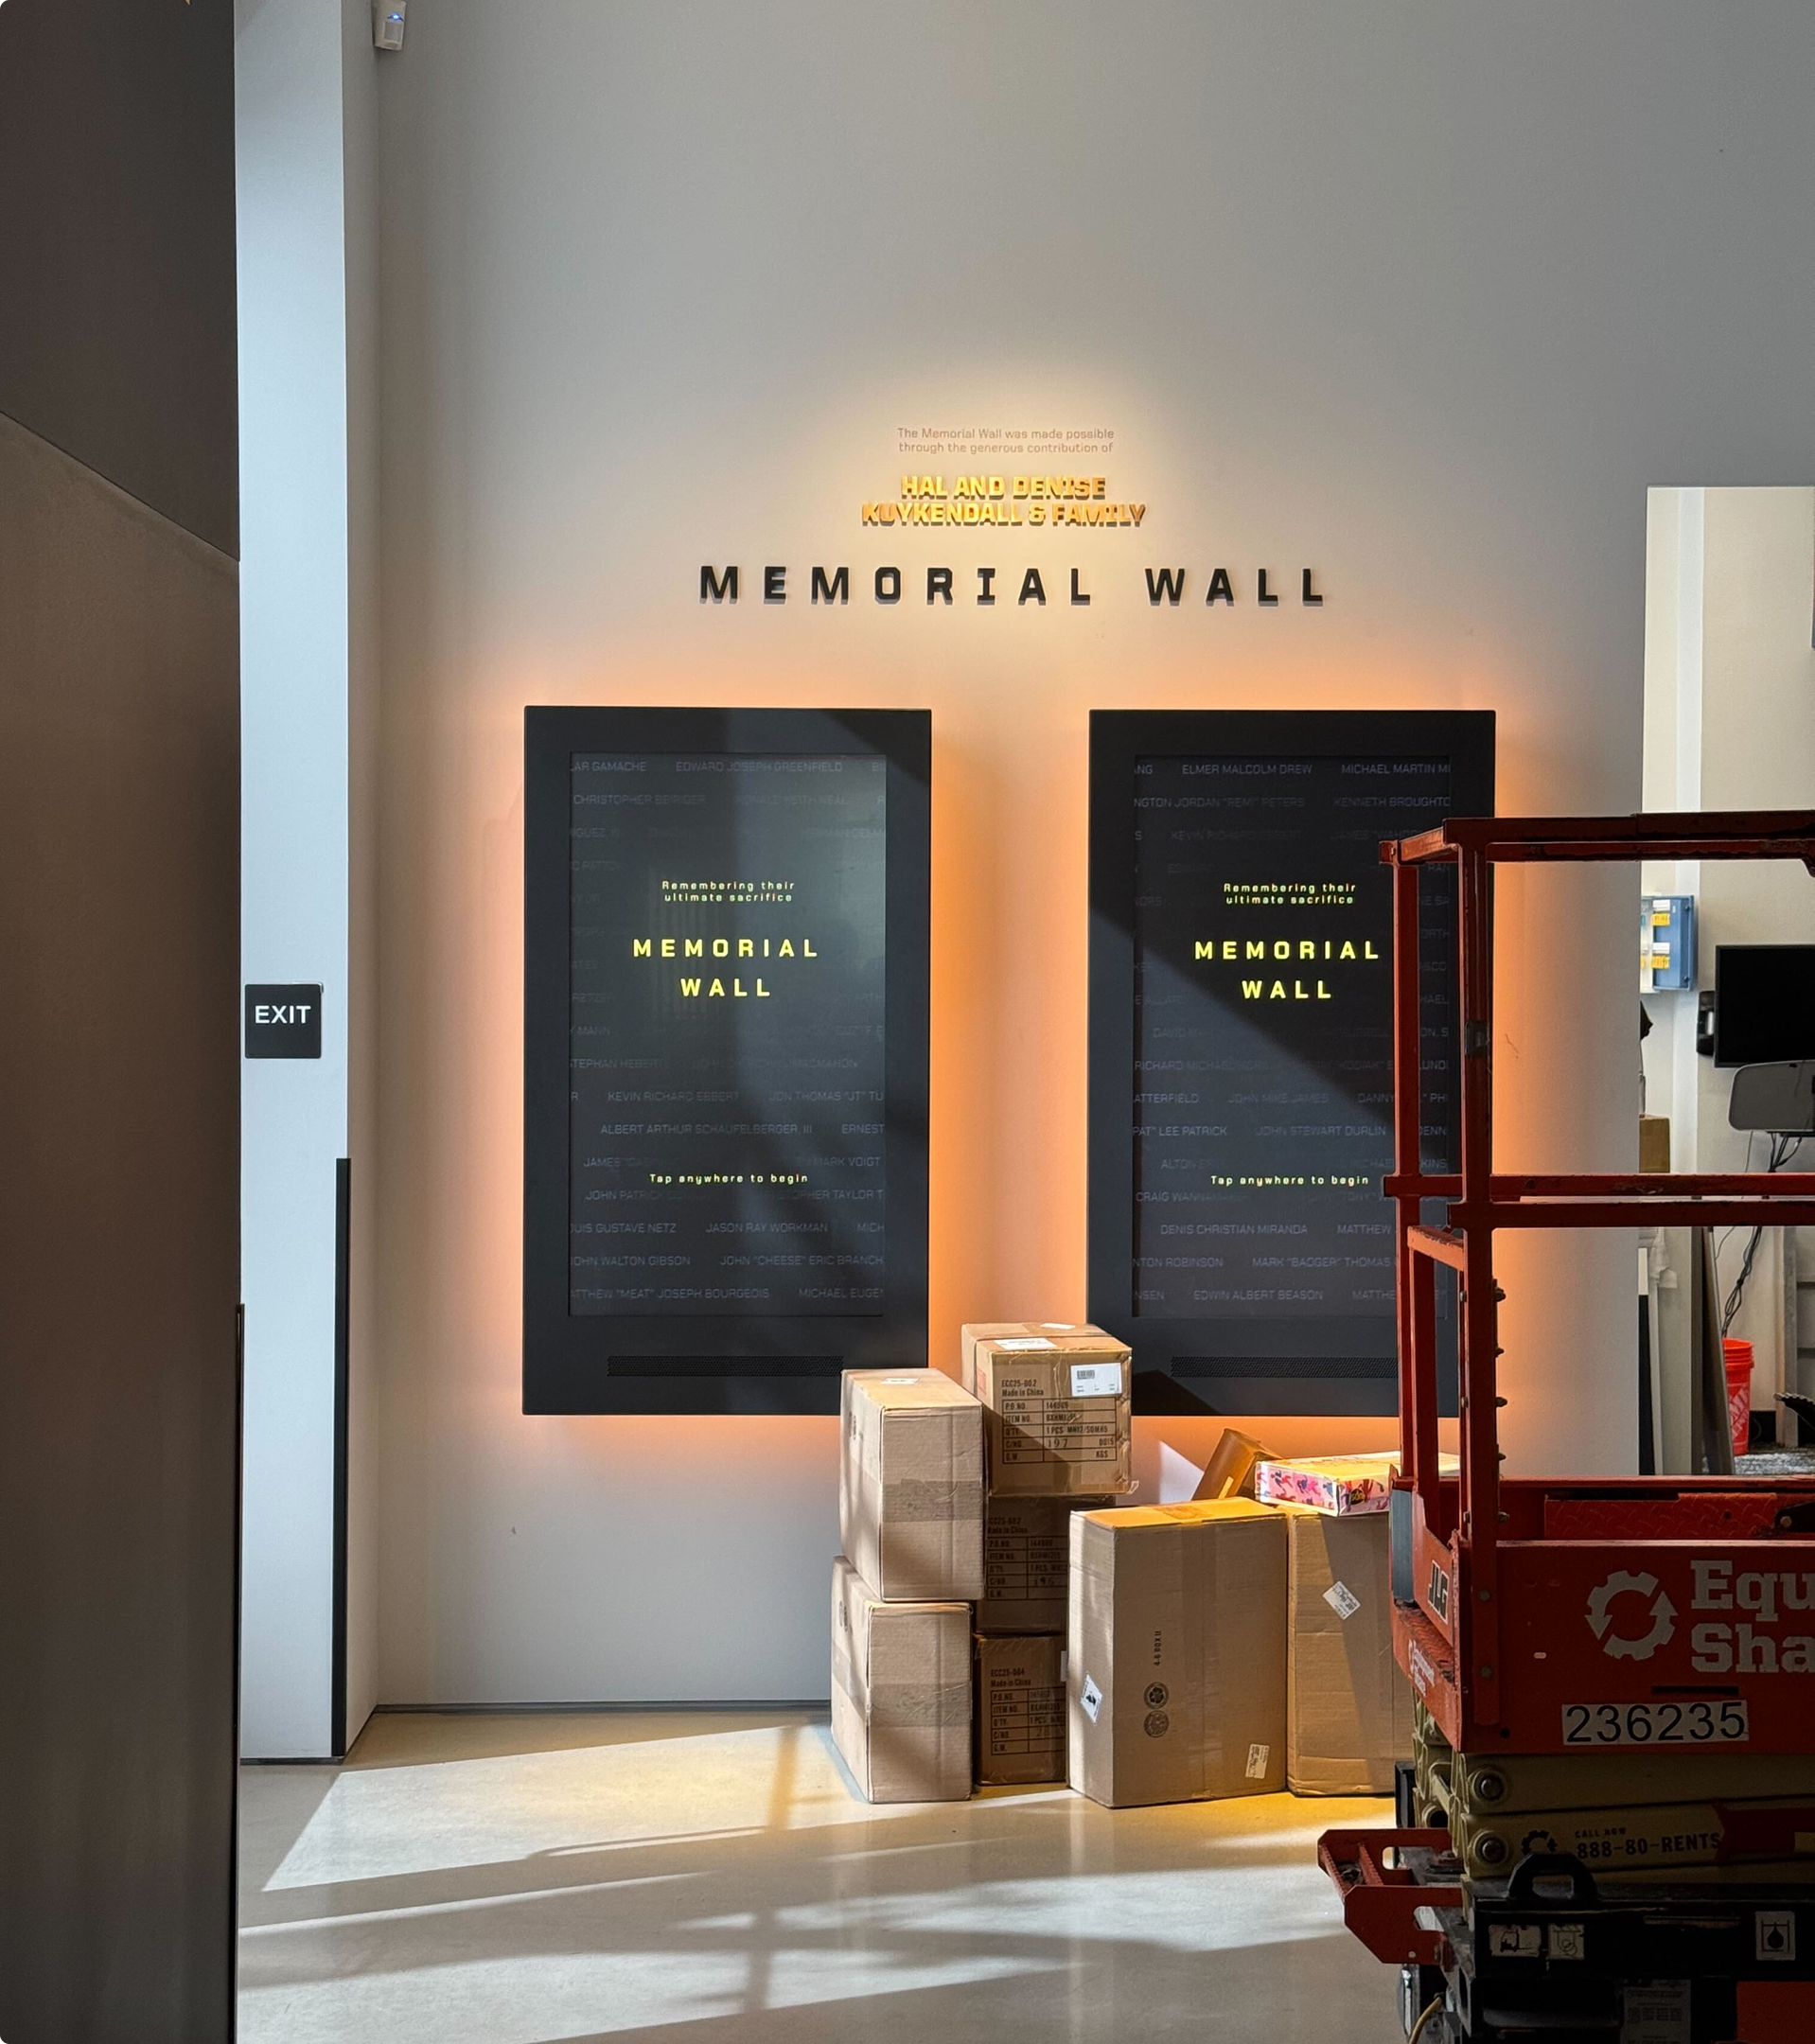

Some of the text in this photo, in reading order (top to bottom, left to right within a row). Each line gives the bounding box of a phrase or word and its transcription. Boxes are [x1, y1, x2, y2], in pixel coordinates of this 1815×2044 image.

[898, 428, 1114, 441] The Memorial Wall was made possible
[899, 442, 1113, 455] through the generous contribution of
[901, 475, 1105, 501] HAL AND DENISE
[862, 502, 1146, 527] KUYKENDALL & FAMILY
[701, 566, 1323, 606] MEMORIAL WALL
[590, 761, 647, 772] GAMACHE
[676, 761, 842, 772] EDWARD JOSEPH GREENFIELD
[1181, 764, 1313, 775] ELMER MALCOLM DREW
[1342, 764, 1435, 774] MICHAEL MARTIN
[573, 794, 651, 805] CHRISTOPHER
[1173, 797, 1221, 808] JORDAN
[661, 880, 795, 892] Remembering their
[1224, 882, 1355, 894] Remembering their
[664, 892, 791, 902] ultimate sacrifice
[1225, 894, 1353, 905] ultimate sacrifice
[633, 938, 818, 958] MEMORIAL
[1195, 941, 1379, 960] MEMORIAL
[680, 978, 770, 997] WALL
[1242, 980, 1331, 999] WALL
[255, 1005, 311, 1024] EXIT
[608, 1091, 642, 1101] KEVIN
[643, 1091, 695, 1101] RICHARD
[768, 1091, 793, 1101] JON
[795, 1091, 842, 1101] THOMAS
[600, 1123, 643, 1135] ALBERT
[645, 1123, 693, 1135] ARTHUR
[840, 1123, 886, 1135] ERNEST
[1158, 1126, 1179, 1137] LEE
[1181, 1126, 1228, 1137] PATRICK
[1255, 1125, 1287, 1137] JOHN
[1289, 1125, 1342, 1137] STEWART
[812, 1156, 882, 1168] MARK VOIGT
[650, 1173, 807, 1186] Tap anywhere to begin
[1211, 1175, 1369, 1188] Tap anywhere to begin
[585, 1189, 617, 1201] JOHN
[833, 1189, 874, 1200] TAYLOR
[1136, 1191, 1170, 1203] CRAIG
[596, 1223, 678, 1233] GUSTAVE NETZ
[706, 1223, 829, 1233] JASON RAY WORKMAN
[1160, 1225, 1308, 1235] DENIS CHRISTIAN MIRANDA
[1336, 1224, 1391, 1235] MATTHEW
[600, 1256, 691, 1266] WALTON GIBSON
[719, 1256, 884, 1266] JOHN "CHEESE" ERIC BRANCH
[1164, 1257, 1225, 1268] ROBINSON
[1251, 1257, 1283, 1268] MARK
[1344, 1257, 1391, 1268] THOMAS
[657, 1288, 702, 1299] JOSEPH
[704, 1288, 770, 1299] BOURGEOIS
[799, 1288, 848, 1299] MICHAEL
[1192, 1290, 1323, 1300] EDWIN ALBERT BEASON
[1026, 1388, 1044, 1397] China
[1050, 1426, 1064, 1435] PCS
[1096, 1450, 1109, 1459] KGS
[1690, 1559, 1815, 1622] Equ
[990, 1679, 1007, 1687] Made
[1565, 1701, 1746, 1743] 236235
[1575, 1827, 1627, 1839] CALL NOW
[1576, 1832, 1720, 1859] 888-80-RENTS
